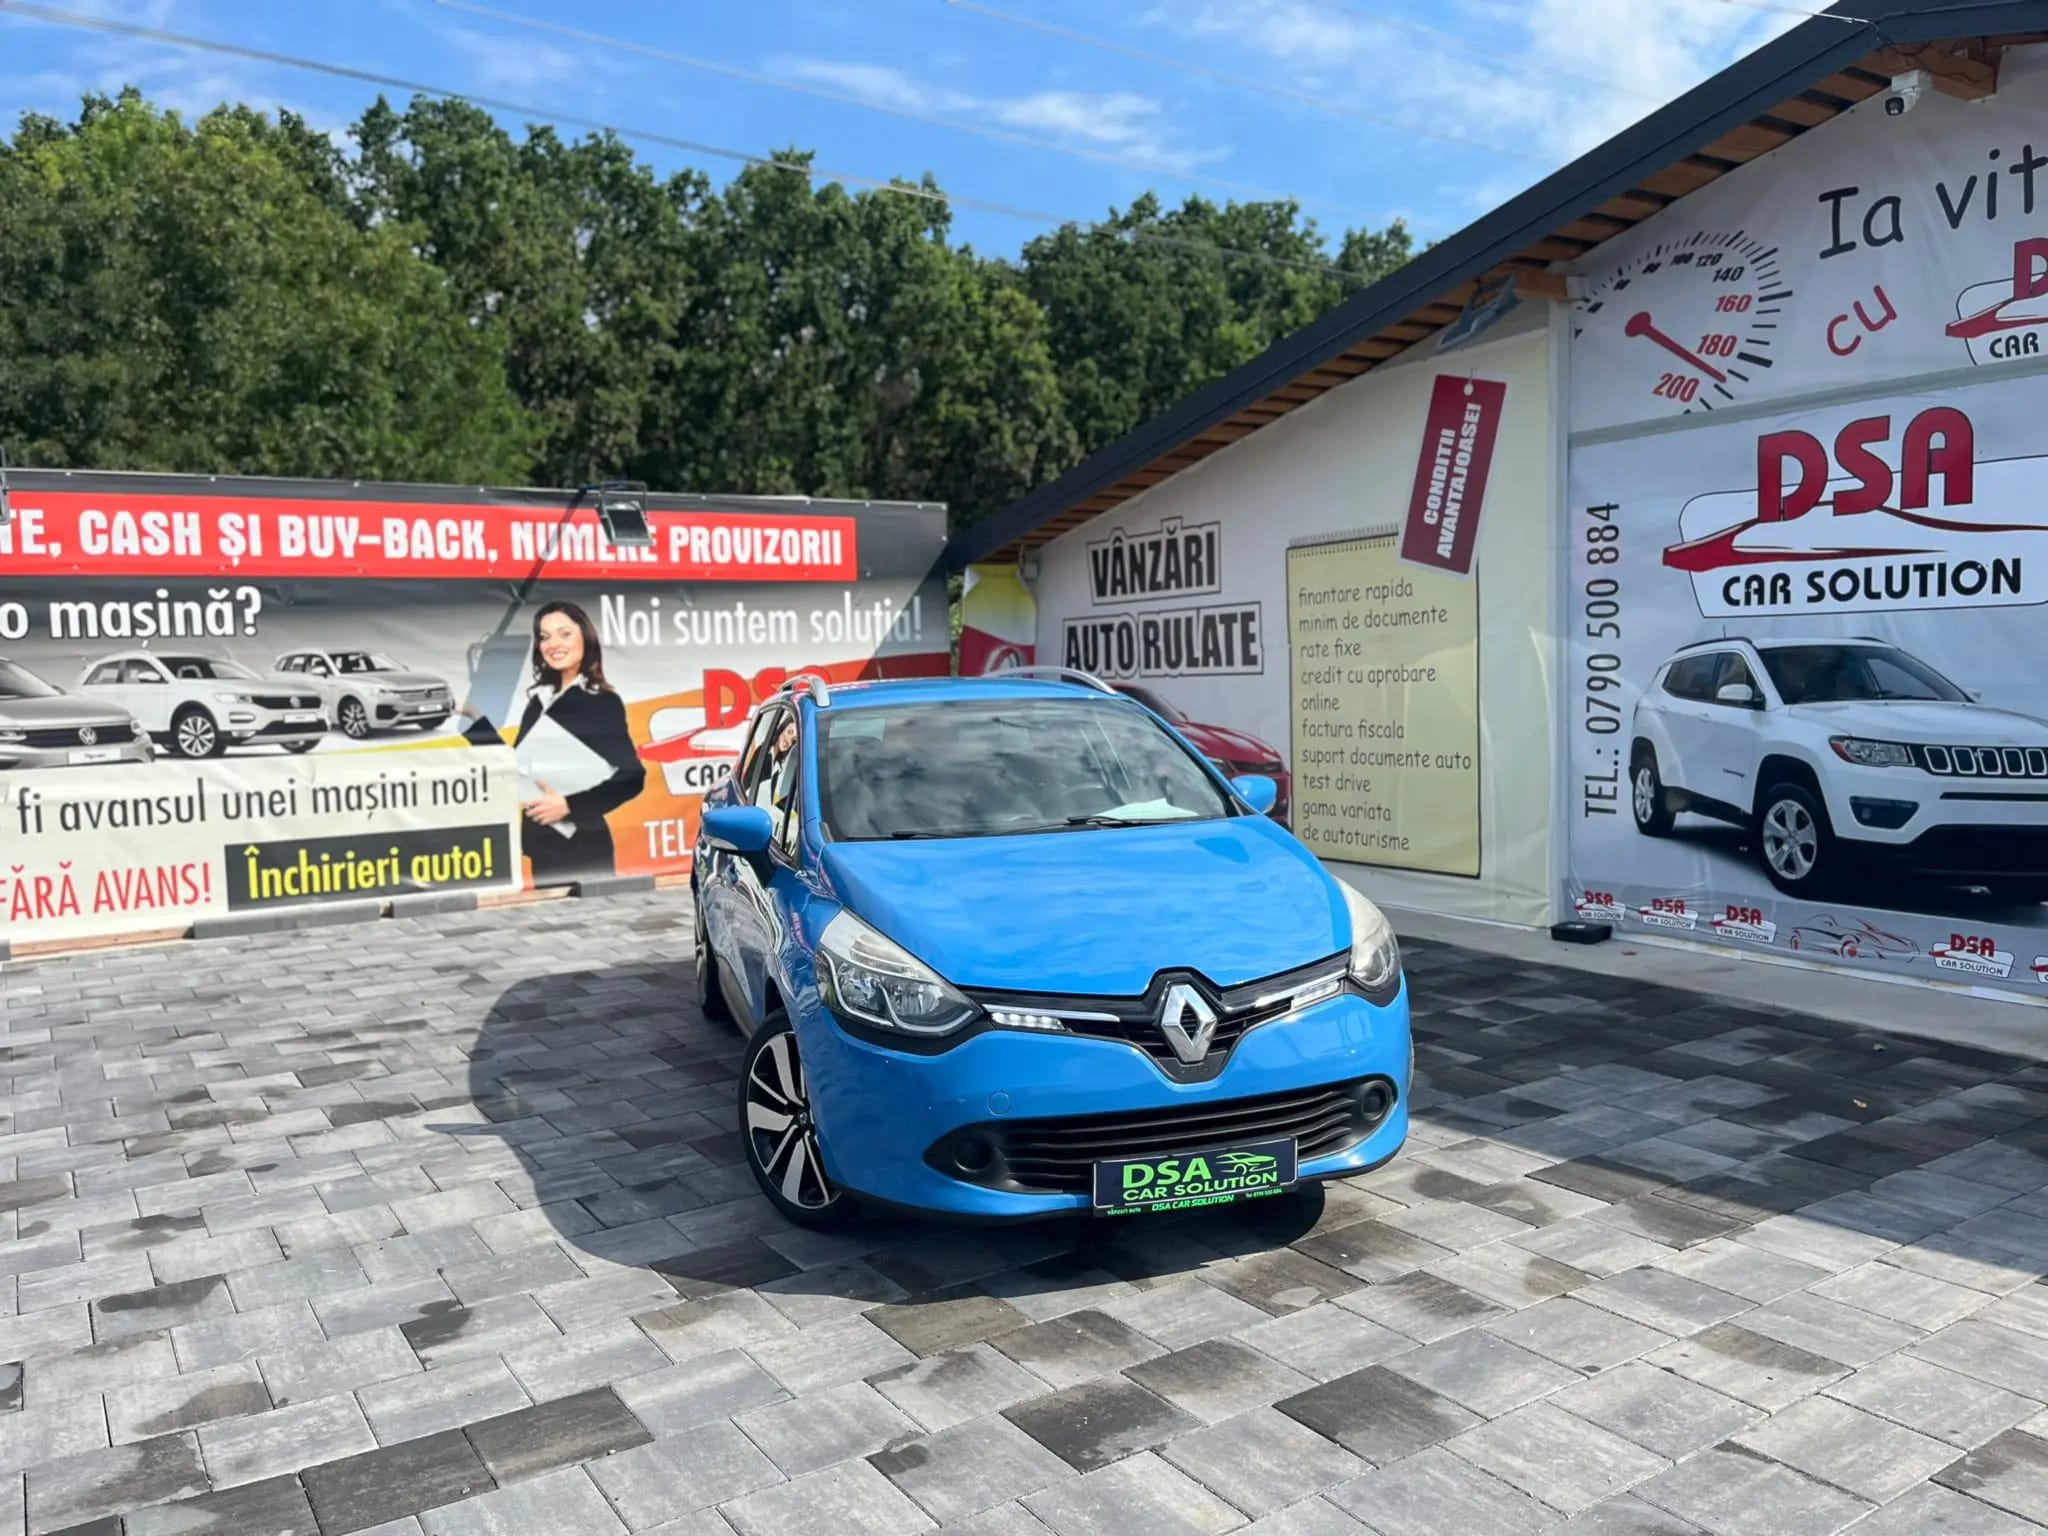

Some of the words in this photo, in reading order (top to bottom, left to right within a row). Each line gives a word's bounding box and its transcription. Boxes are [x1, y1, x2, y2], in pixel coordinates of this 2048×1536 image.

[1818, 185, 1905, 260] Ia
[1695, 253, 1723, 267] 120
[1712, 266, 1745, 282] 140
[1714, 294, 1752, 312] 160
[1826, 284, 1898, 357] cu
[1696, 334, 1738, 357] 180
[1988, 331, 2040, 359] CAR
[1652, 372, 1699, 403] 200
[1757, 406, 1975, 524] DSA
[1436, 402, 1482, 560] AVANTAJOASE!
[78, 509, 203, 557] CASH
[216, 512, 263, 568] ȘI
[277, 514, 499, 563] BUY-BACK,
[669, 524, 843, 567] PROVIZORII
[1585, 502, 1621, 565] 884
[1092, 525, 1216, 598] VÂNZĂRI
[1298, 586, 1361, 608] finantare
[1365, 576, 1414, 606] rapida
[1721, 571, 1792, 608] CAR
[1806, 557, 2022, 605] SOLUTION
[0, 601, 29, 639] o
[49, 585, 263, 649] mașină?
[600, 594, 661, 646] Noi
[673, 601, 799, 646] suntem
[1298, 614, 1338, 633] minim
[1342, 610, 1360, 631] de
[1364, 605, 1449, 629] documente
[1585, 578, 1621, 639] 500
[1065, 620, 1136, 673] AUTO
[1141, 611, 1259, 671] RULATE
[1299, 643, 1330, 659] rate
[1334, 637, 1362, 659] fixe
[1301, 665, 1343, 684] credit
[1347, 669, 1364, 684] cu
[1367, 664, 1437, 689] aprobare
[1301, 692, 1341, 712] online
[1585, 653, 1621, 735] 0790
[1301, 717, 1353, 738] factura
[1358, 719, 1405, 740] fiscala
[1301, 747, 1345, 771] suport
[1350, 746, 1431, 768] documente
[1435, 751, 1472, 771] auto
[1302, 772, 1331, 791] test
[1335, 771, 1372, 793] drive
[17, 786, 42, 835] fi
[59, 777, 206, 832] avansul
[222, 777, 297, 820] unei
[312, 770, 418, 821] mașini
[431, 764, 490, 806] noi!
[1302, 801, 1337, 820] gama
[1341, 801, 1392, 822] variata
[1302, 823, 1320, 841] de
[1323, 828, 1410, 851] autoturisme
[243, 844, 401, 900] Închirieri
[411, 836, 494, 884] auto!
[93, 861, 212, 914] AVANS!
[1584, 891, 1614, 906] DSA
[1651, 898, 1685, 915] DSA
[1726, 905, 1762, 926] DSA
[1660, 918, 1692, 928] SOLUTION
[1734, 929, 1770, 941] SOLUTION
[1950, 933, 1996, 958] DSA
[1960, 961, 2003, 976] SOLUTION
[1123, 1157, 1213, 1189] DSA
[1123, 1186, 1167, 1201] CAR
[1174, 1171, 1279, 1197] SOLUTION
[1151, 1203, 1170, 1212] DSA
[1172, 1200, 1190, 1209] CAR
[1191, 1195, 1235, 1207] SOLUTION
